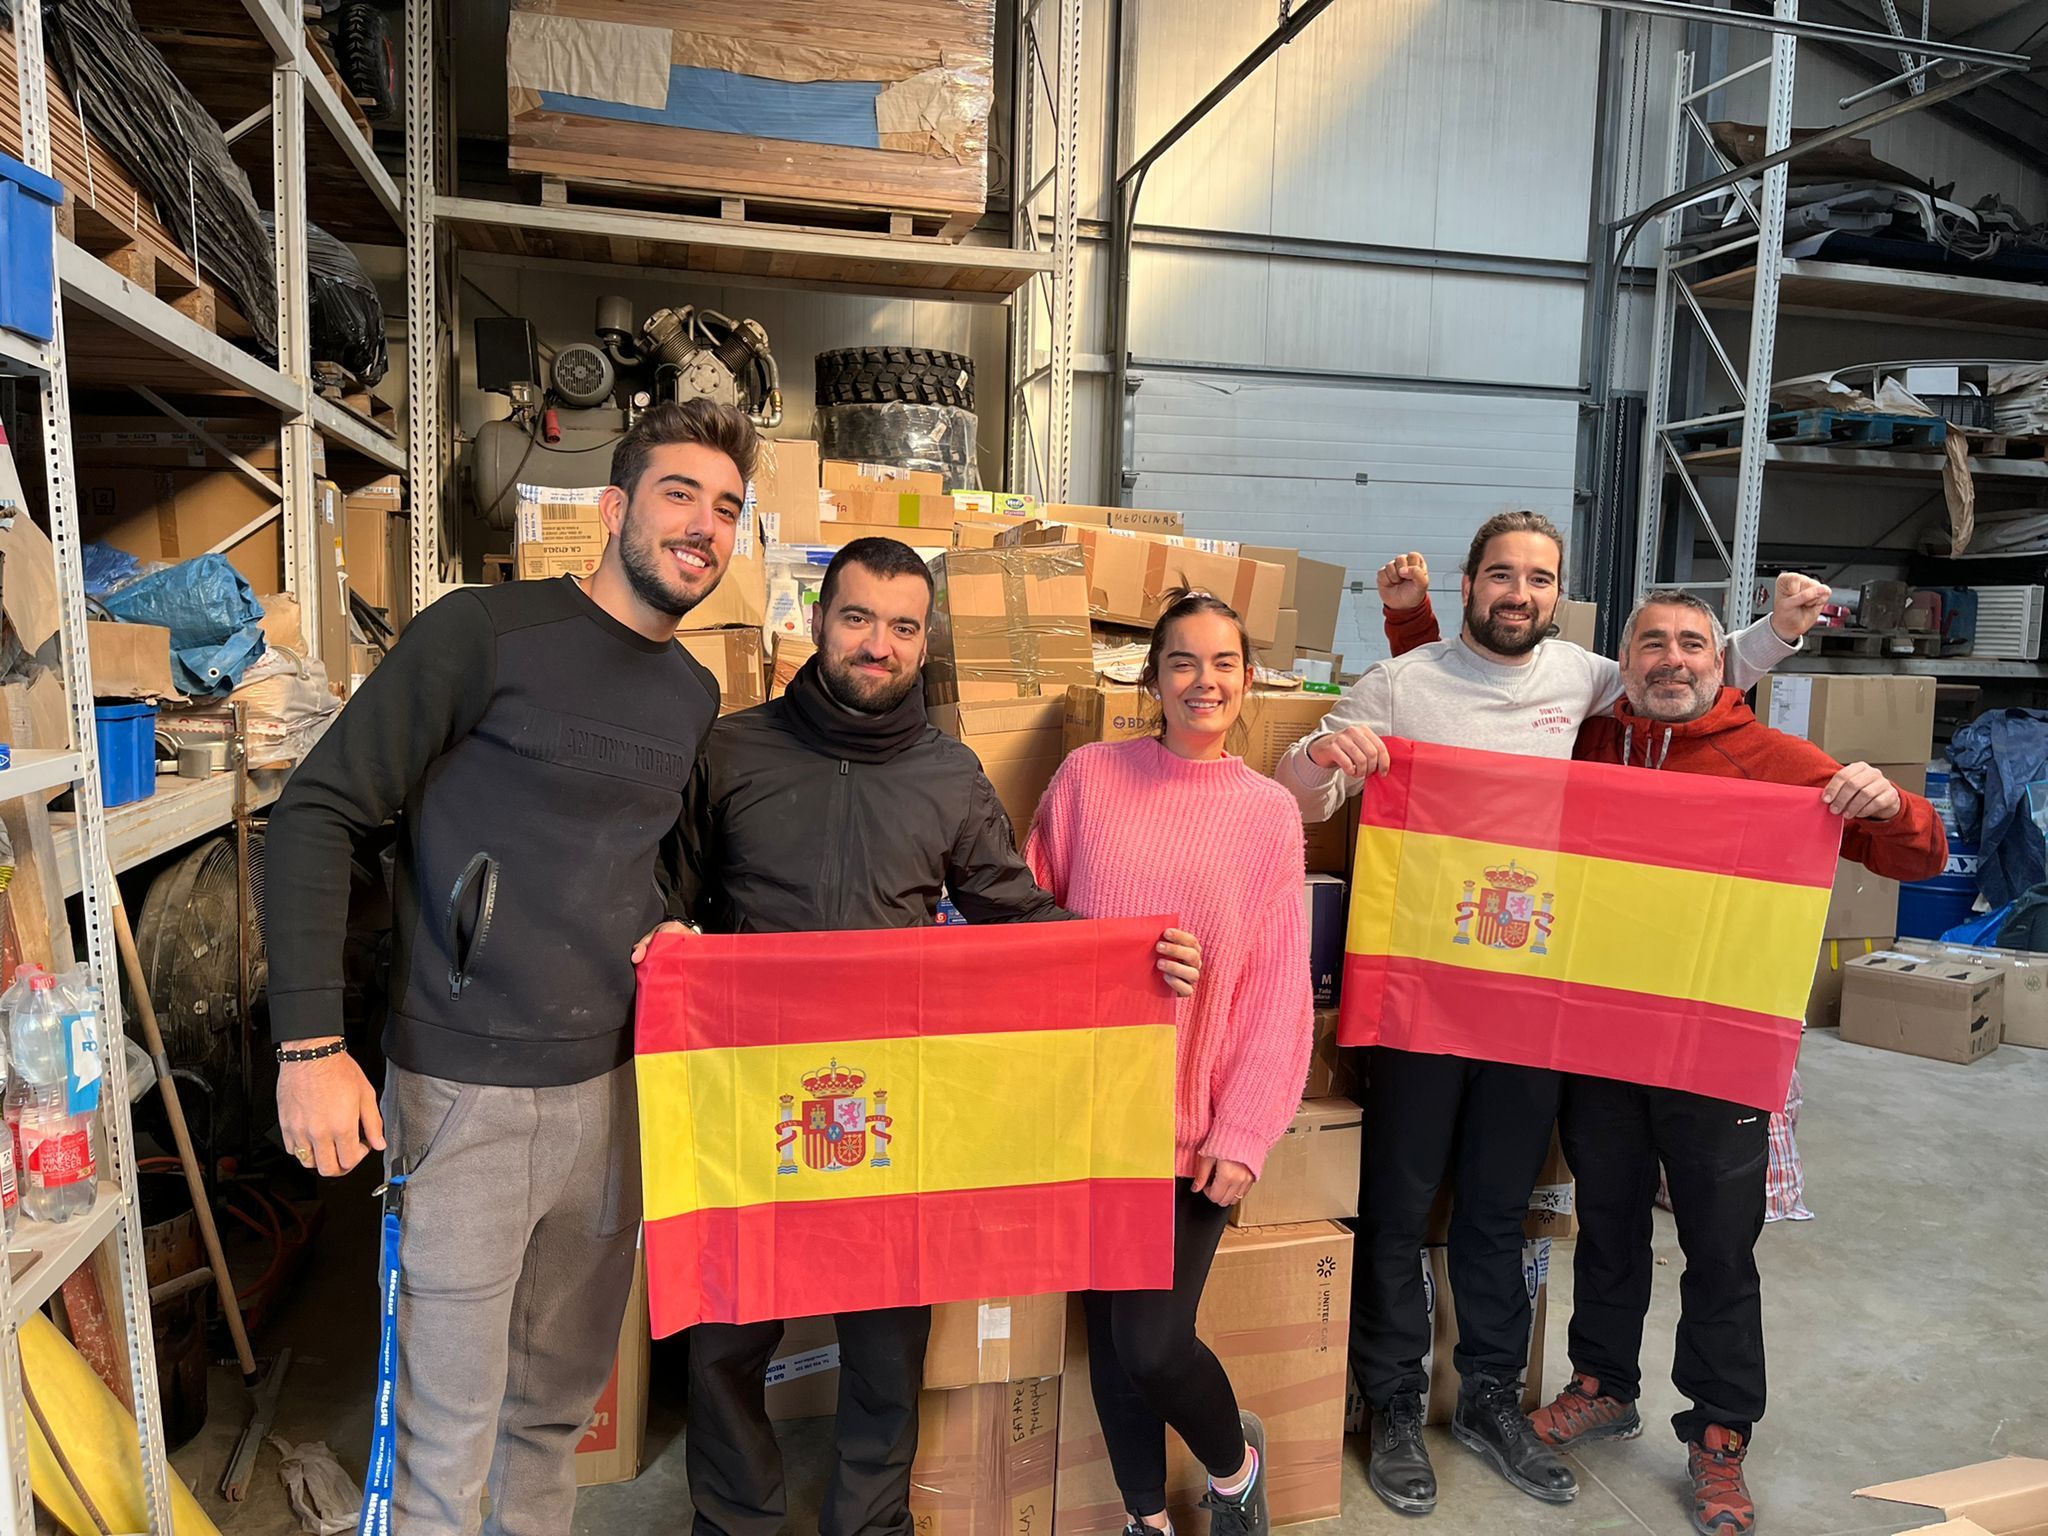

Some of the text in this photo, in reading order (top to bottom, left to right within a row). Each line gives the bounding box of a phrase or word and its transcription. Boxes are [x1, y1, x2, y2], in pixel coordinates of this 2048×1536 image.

[1115, 512, 1177, 527] MEDICINAS
[1127, 717, 1145, 729] BD
[1531, 716, 1572, 729] INTERNATIONAL
[567, 728, 683, 780] ANTONY MORATO
[1321, 973, 1332, 985] M
[42, 1158, 82, 1173] WASSER
[387, 1268, 398, 1316] MEGASUR
[1321, 1290, 1330, 1325] UNITED
[379, 1379, 391, 1427] MEGASUR
